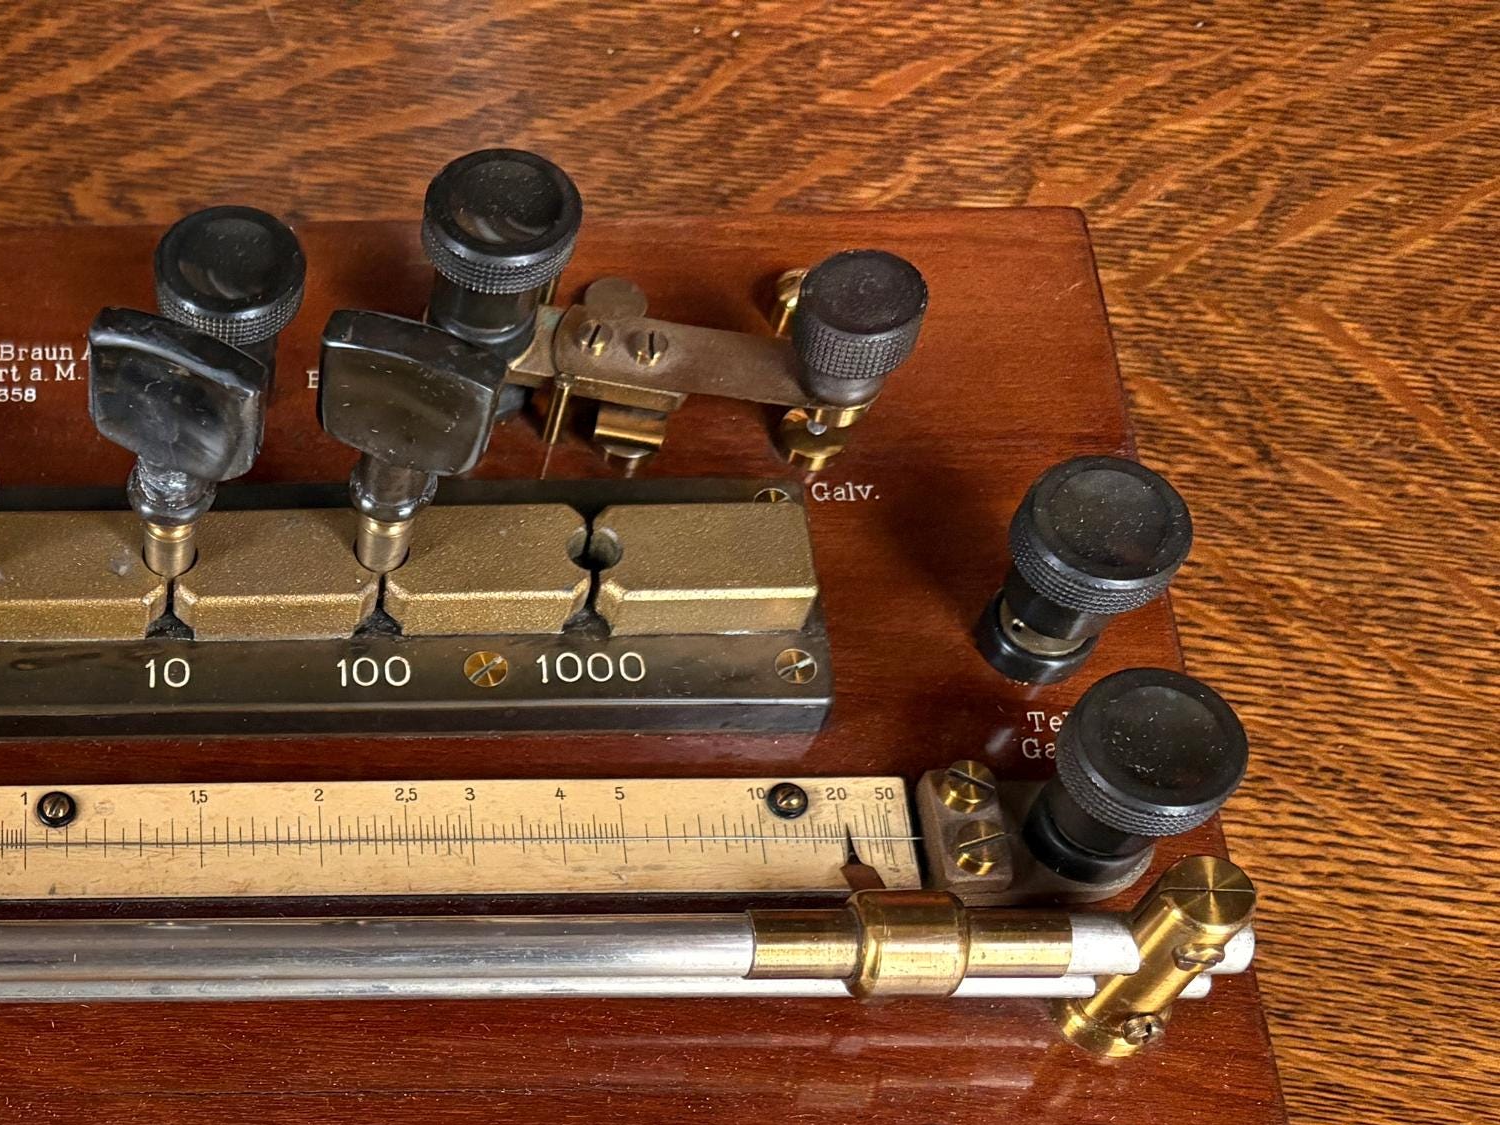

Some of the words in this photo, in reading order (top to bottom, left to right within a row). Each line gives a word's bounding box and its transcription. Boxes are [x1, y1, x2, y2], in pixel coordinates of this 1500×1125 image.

[0, 344, 74, 362] Braun
[811, 481, 881, 502] Galv.
[145, 658, 190, 689] 10
[337, 656, 411, 687] 100
[536, 652, 645, 683] 1000
[1027, 711, 1069, 732] Te
[19, 792, 28, 806] 1
[189, 789, 208, 805] 1,5
[314, 788, 324, 802] 2
[394, 788, 418, 804] 2,5
[464, 787, 476, 801] 3
[555, 787, 567, 800] 4
[614, 787, 626, 801] 5
[747, 787, 766, 801] 10
[826, 787, 847, 801] 20
[875, 787, 894, 801] 50
